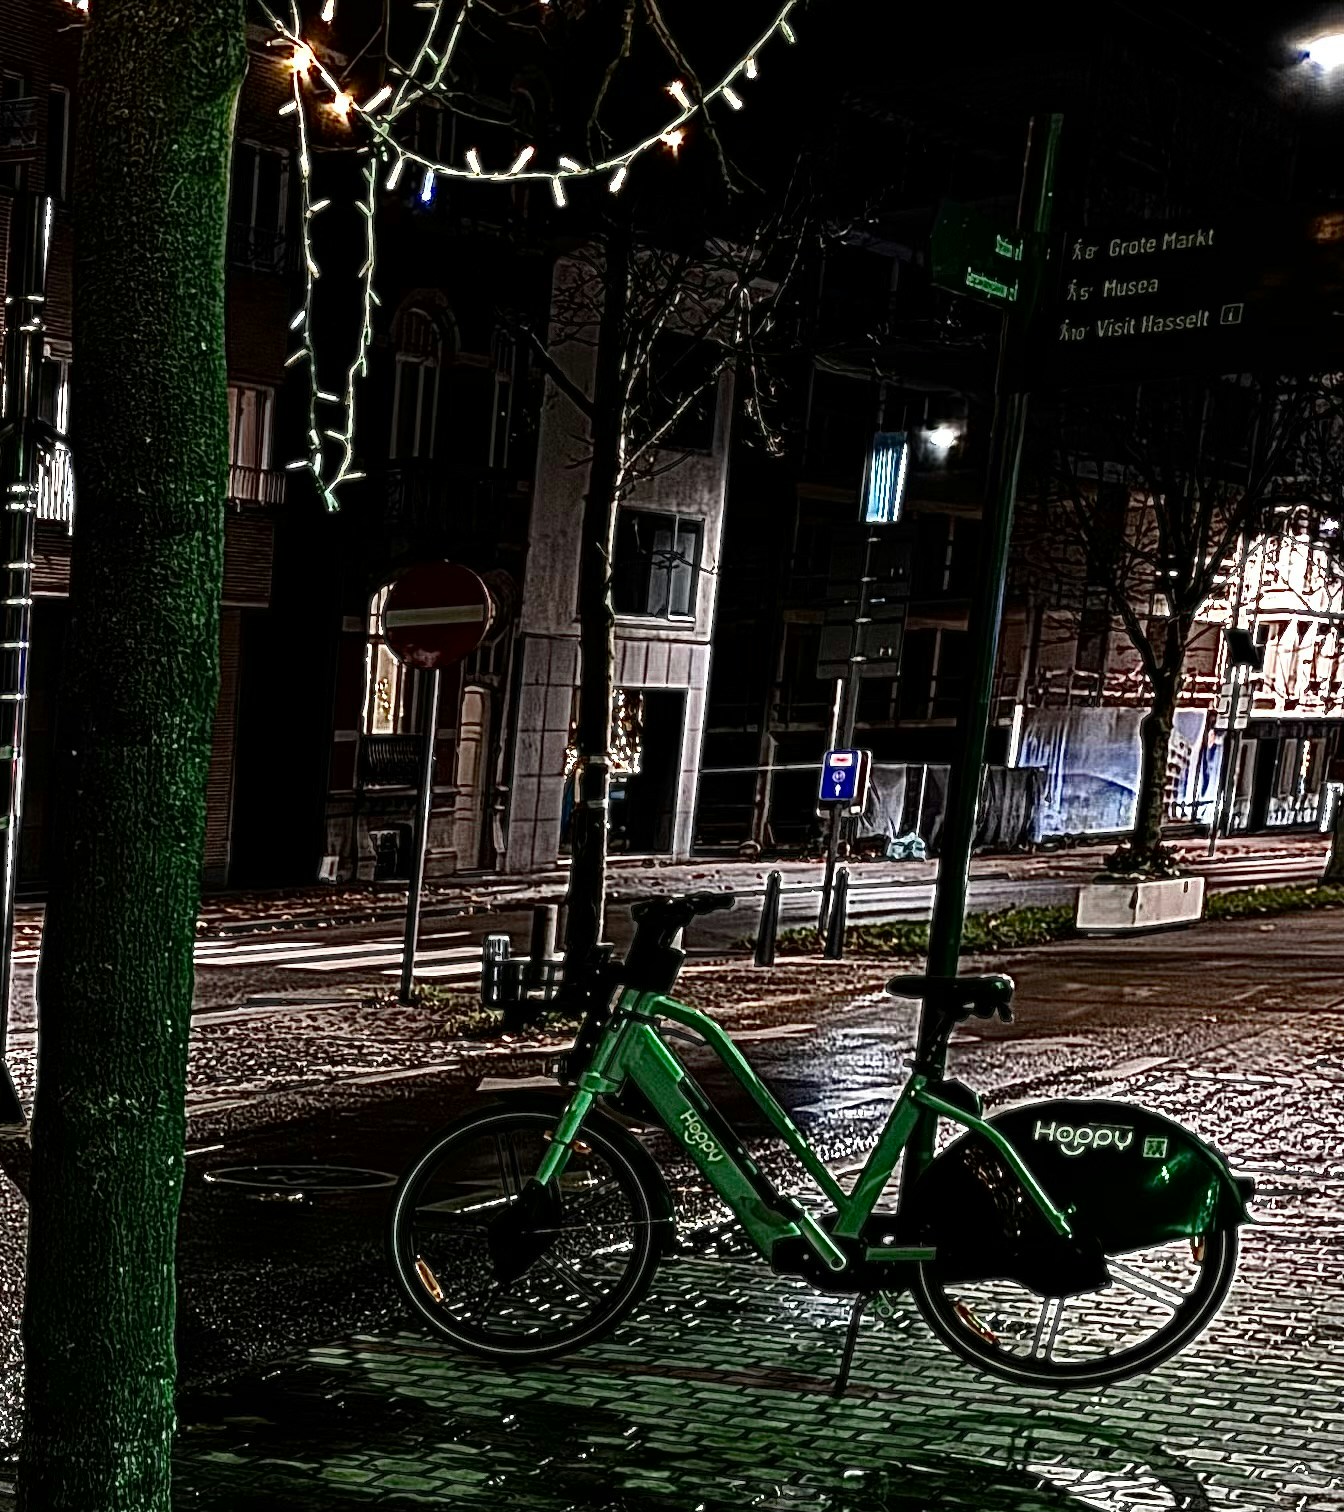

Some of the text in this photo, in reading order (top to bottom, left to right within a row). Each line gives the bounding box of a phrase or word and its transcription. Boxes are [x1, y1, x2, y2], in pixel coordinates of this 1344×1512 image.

[1109, 237, 1157, 257] Grote
[1162, 228, 1214, 251] Markt
[1103, 278, 1159, 298] Musea
[1096, 316, 1135, 338] Visit
[1141, 309, 1209, 334] Hasselt
[679, 1109, 724, 1162] Hoppy
[1034, 1119, 1133, 1155] Hoppy
